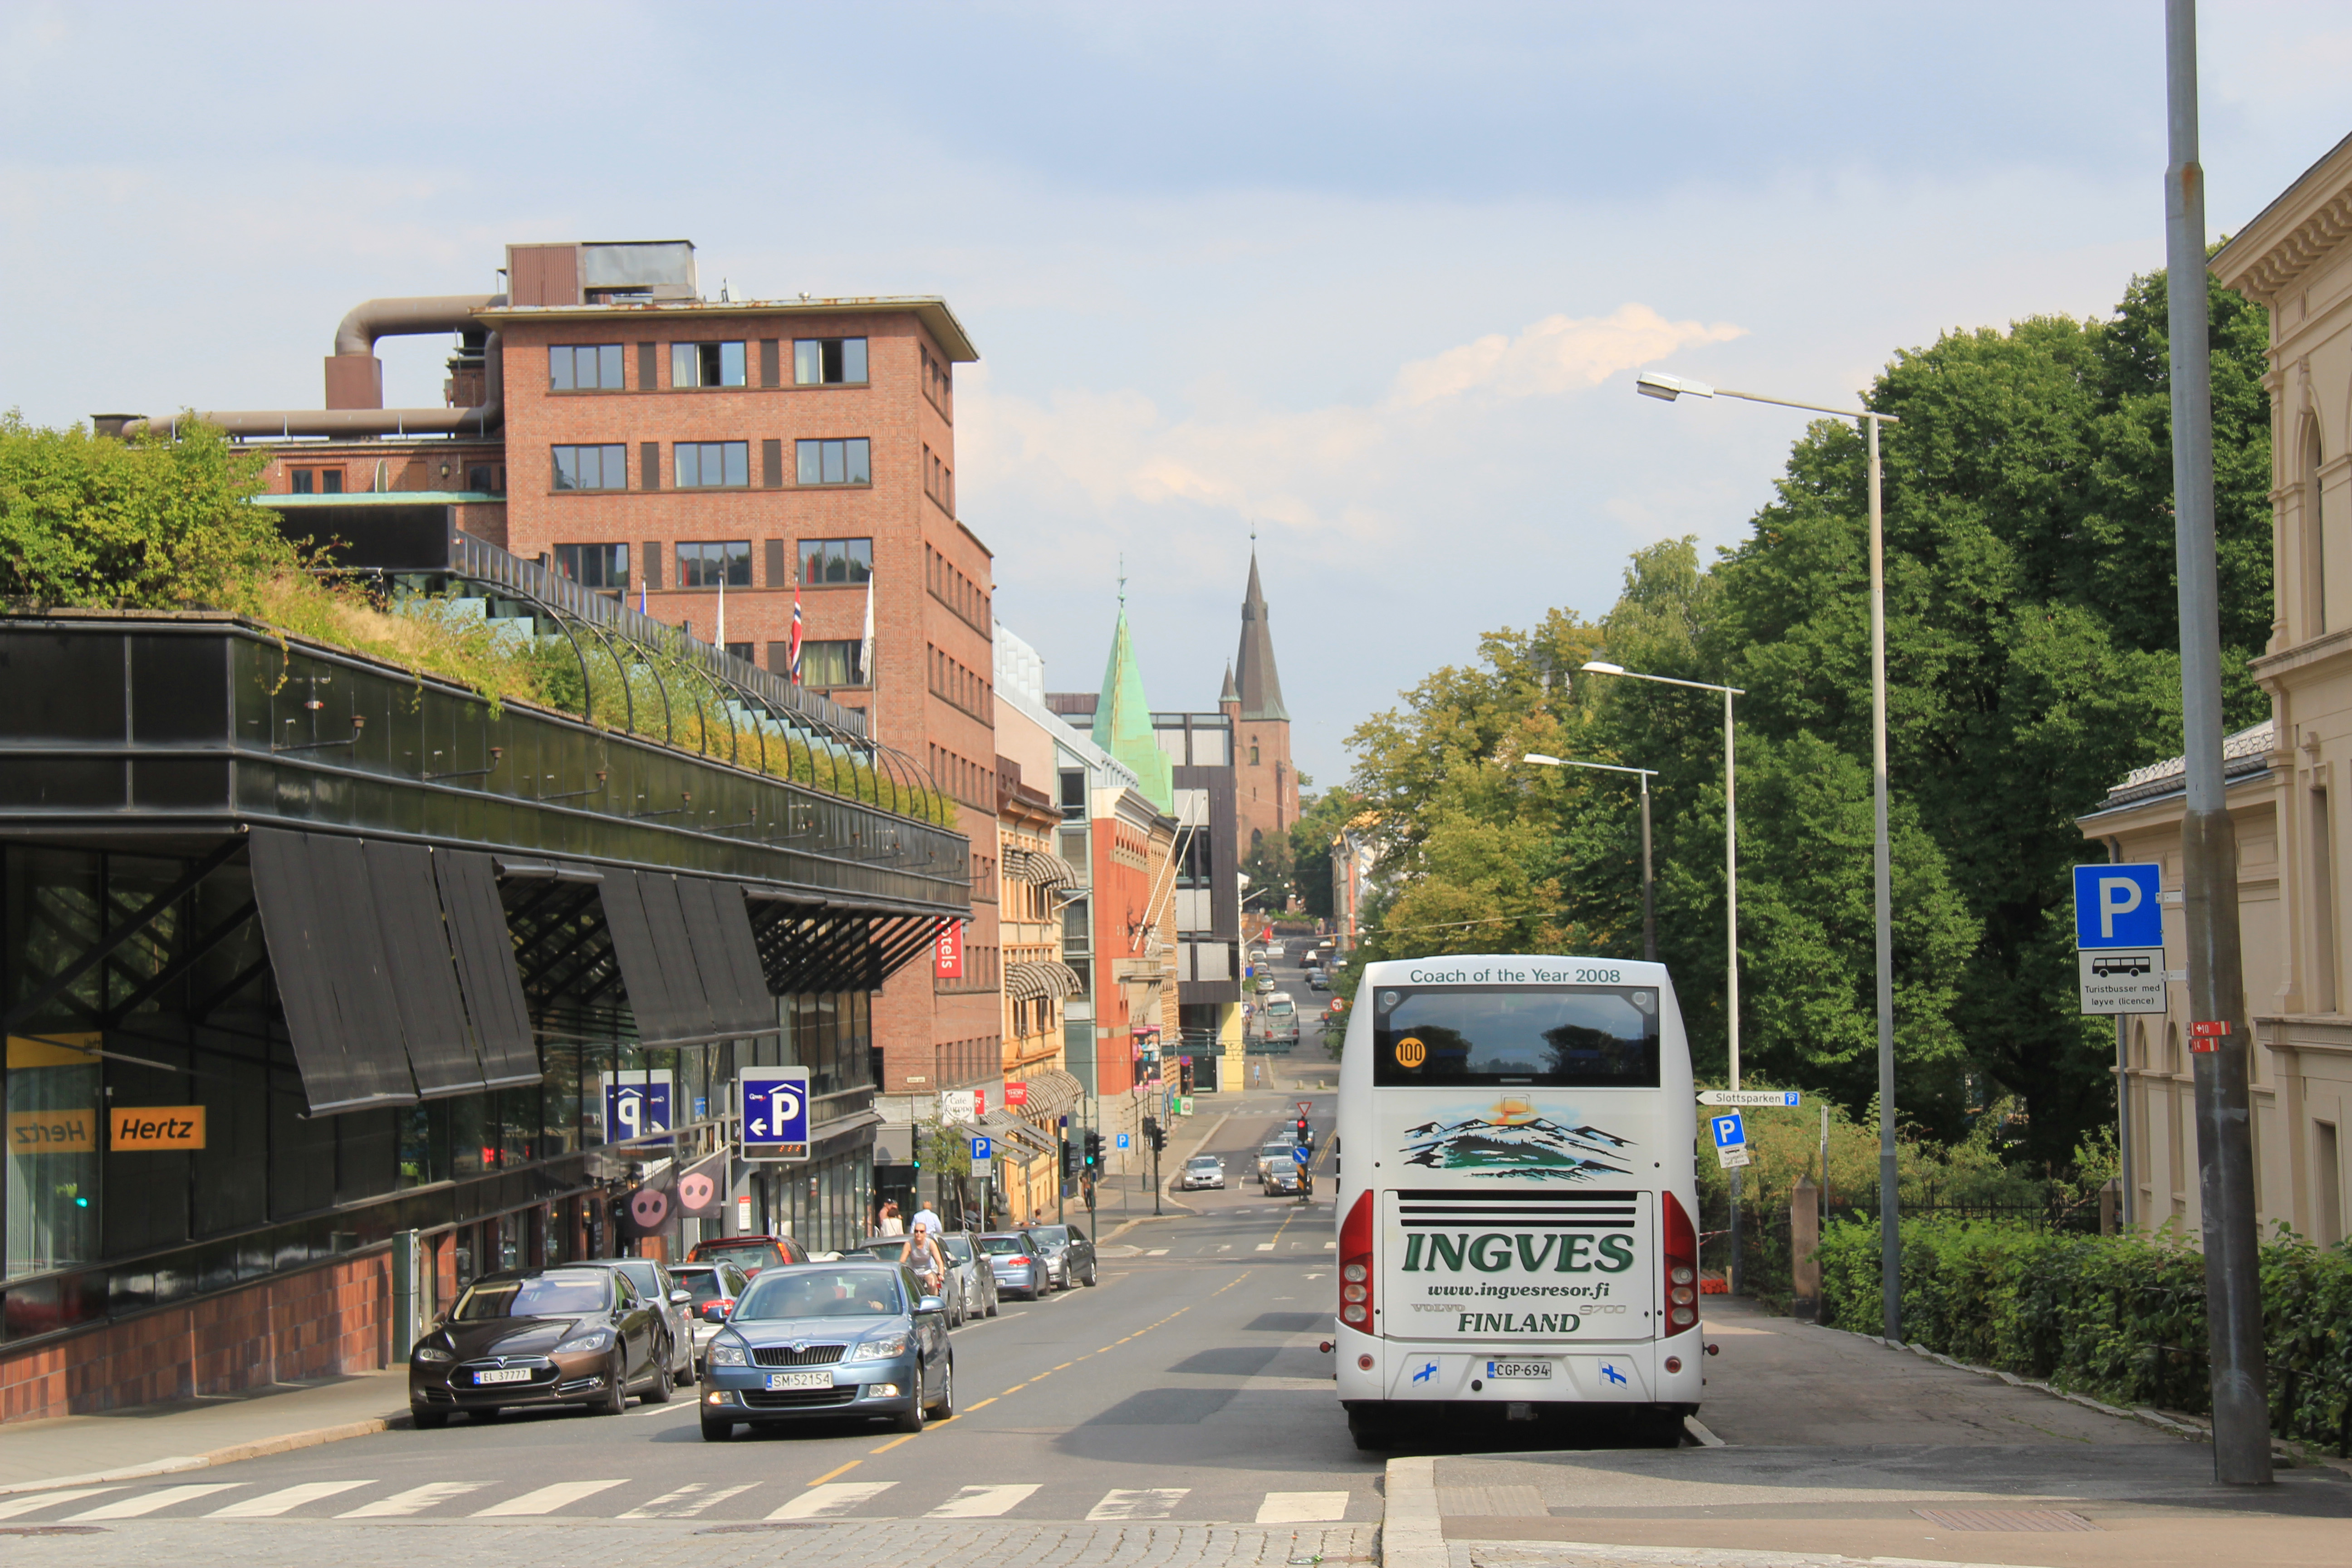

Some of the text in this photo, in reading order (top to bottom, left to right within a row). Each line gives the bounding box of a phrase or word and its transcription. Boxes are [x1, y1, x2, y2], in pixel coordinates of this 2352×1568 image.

[2099, 877, 2141, 938] P
[1410, 969, 1620, 983] Coach of the Year 2008
[2092, 998, 2113, 1007] løyve
[1399, 1044, 1422, 1061] 100
[1716, 1093, 1780, 1104] Slottsparken
[772, 1092, 800, 1136] P
[120, 1118, 194, 1140] Hertz
[1719, 1119, 1735, 1143] P
[975, 1139, 986, 1157] P
[1119, 1135, 1126, 1146] P
[1402, 1233, 1634, 1273] INGVES
[1428, 1282, 1609, 1299] www.ingvesresor.fi
[1411, 1303, 1465, 1312] VOLVO
[1458, 1313, 1580, 1332] FINLAND
[484, 1370, 526, 1382] EL 37777
[1497, 1364, 1548, 1376] CGP-694
[774, 1373, 830, 1387] SM 52154
